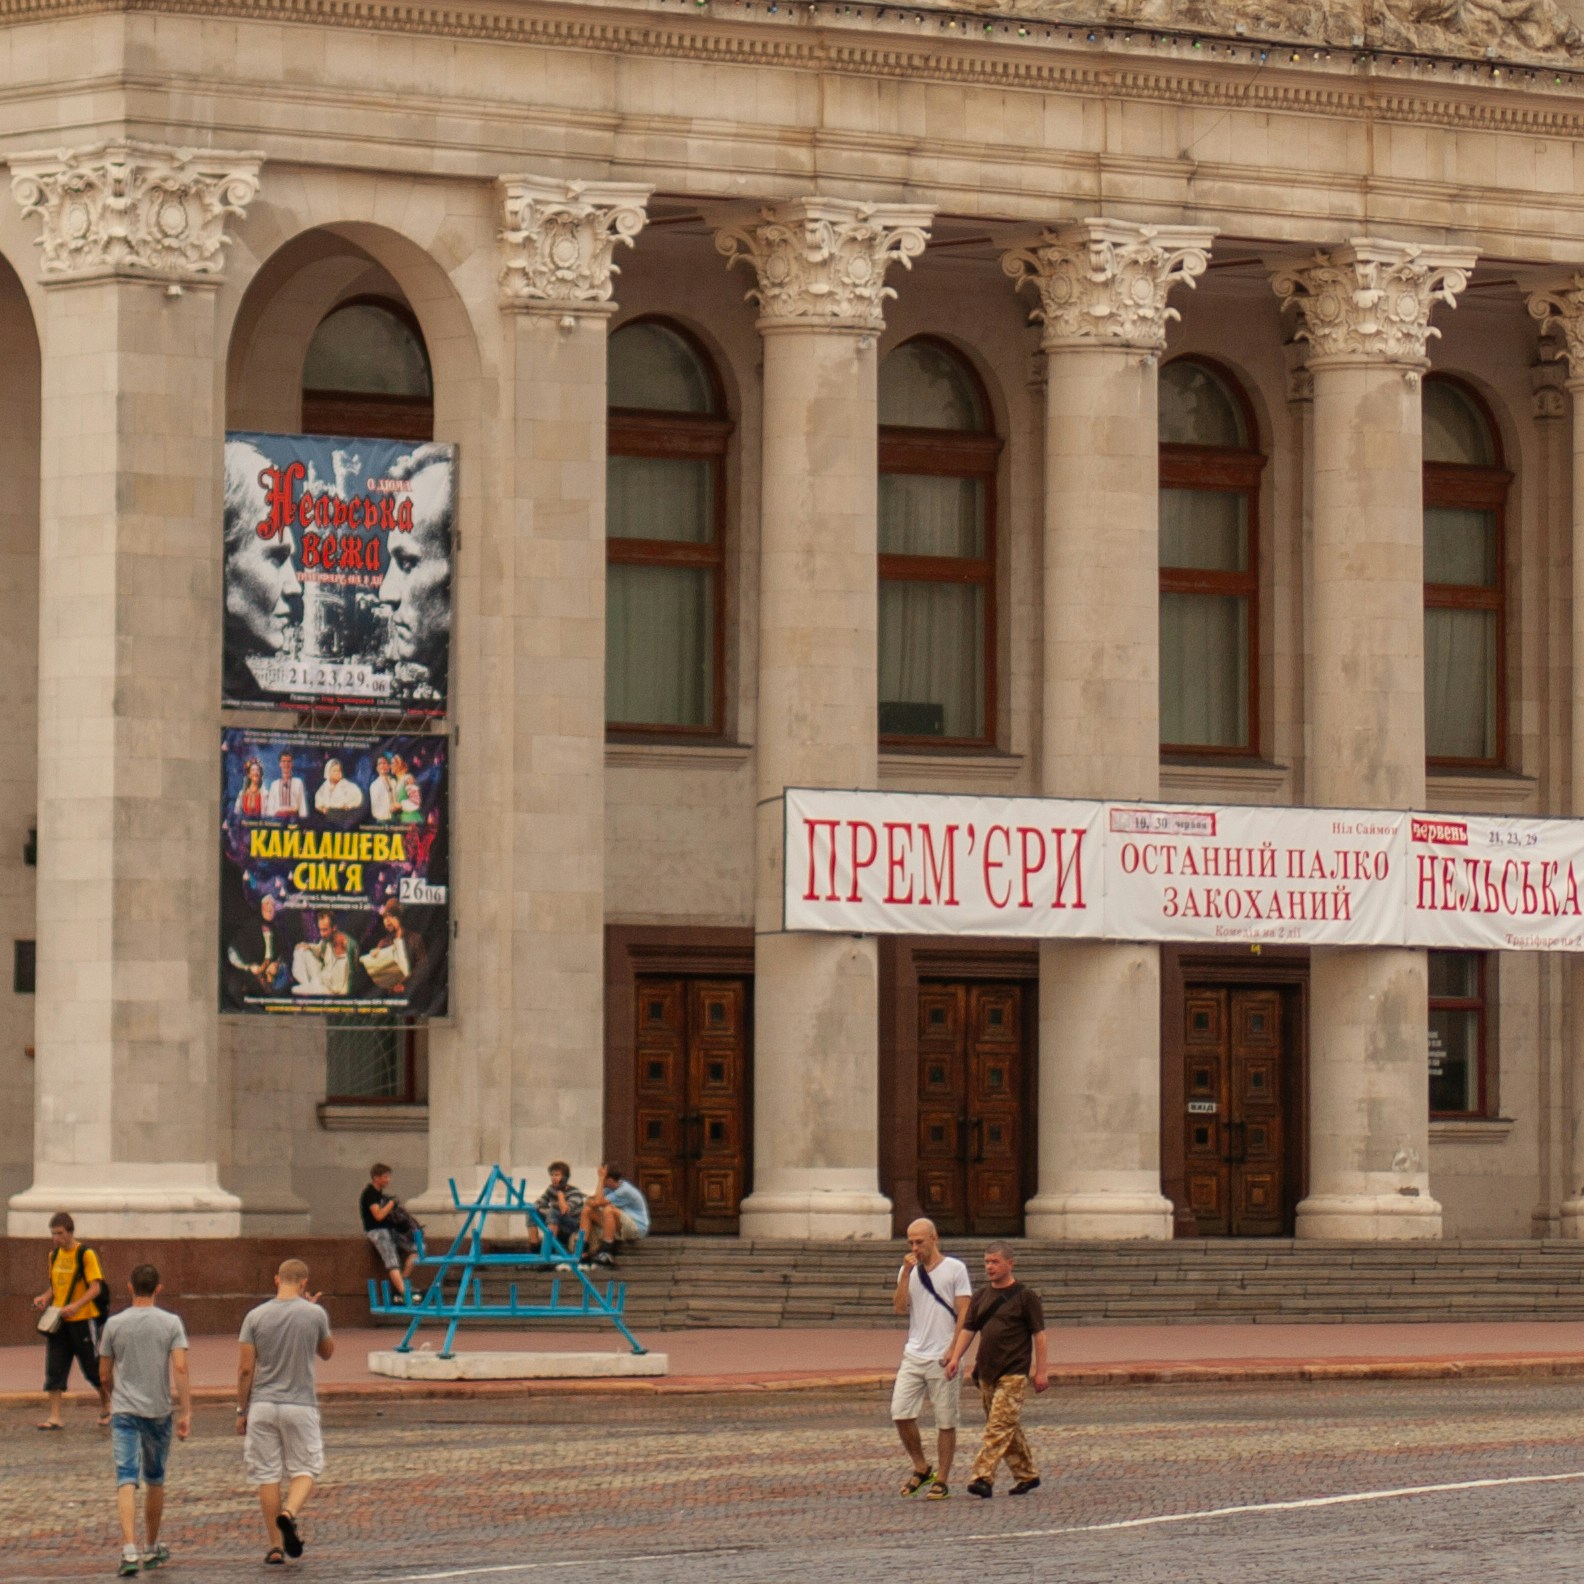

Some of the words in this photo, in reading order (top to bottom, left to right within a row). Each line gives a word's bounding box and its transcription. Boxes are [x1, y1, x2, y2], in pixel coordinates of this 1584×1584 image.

[257, 461, 414, 543] Нельська
[301, 531, 381, 571] вежа
[1156, 817, 1168, 829] 30
[1356, 822, 1399, 835] Саймон
[1526, 833, 1538, 846] 29
[250, 824, 406, 861] КАЙДАШЕВА
[1120, 841, 1277, 878] ОСТАННІЙ
[1286, 849, 1390, 881] ПАЛКО
[293, 862, 363, 892] СІМ'Я
[1416, 855, 1582, 916] НЕЛЬСЬКА
[1163, 884, 1352, 921] ЗАКОХАНИЙ
[1216, 924, 1260, 937] Комедія
[1263, 928, 1275, 937] на
[1278, 926, 1285, 938] 2
[1288, 926, 1302, 938] дії
